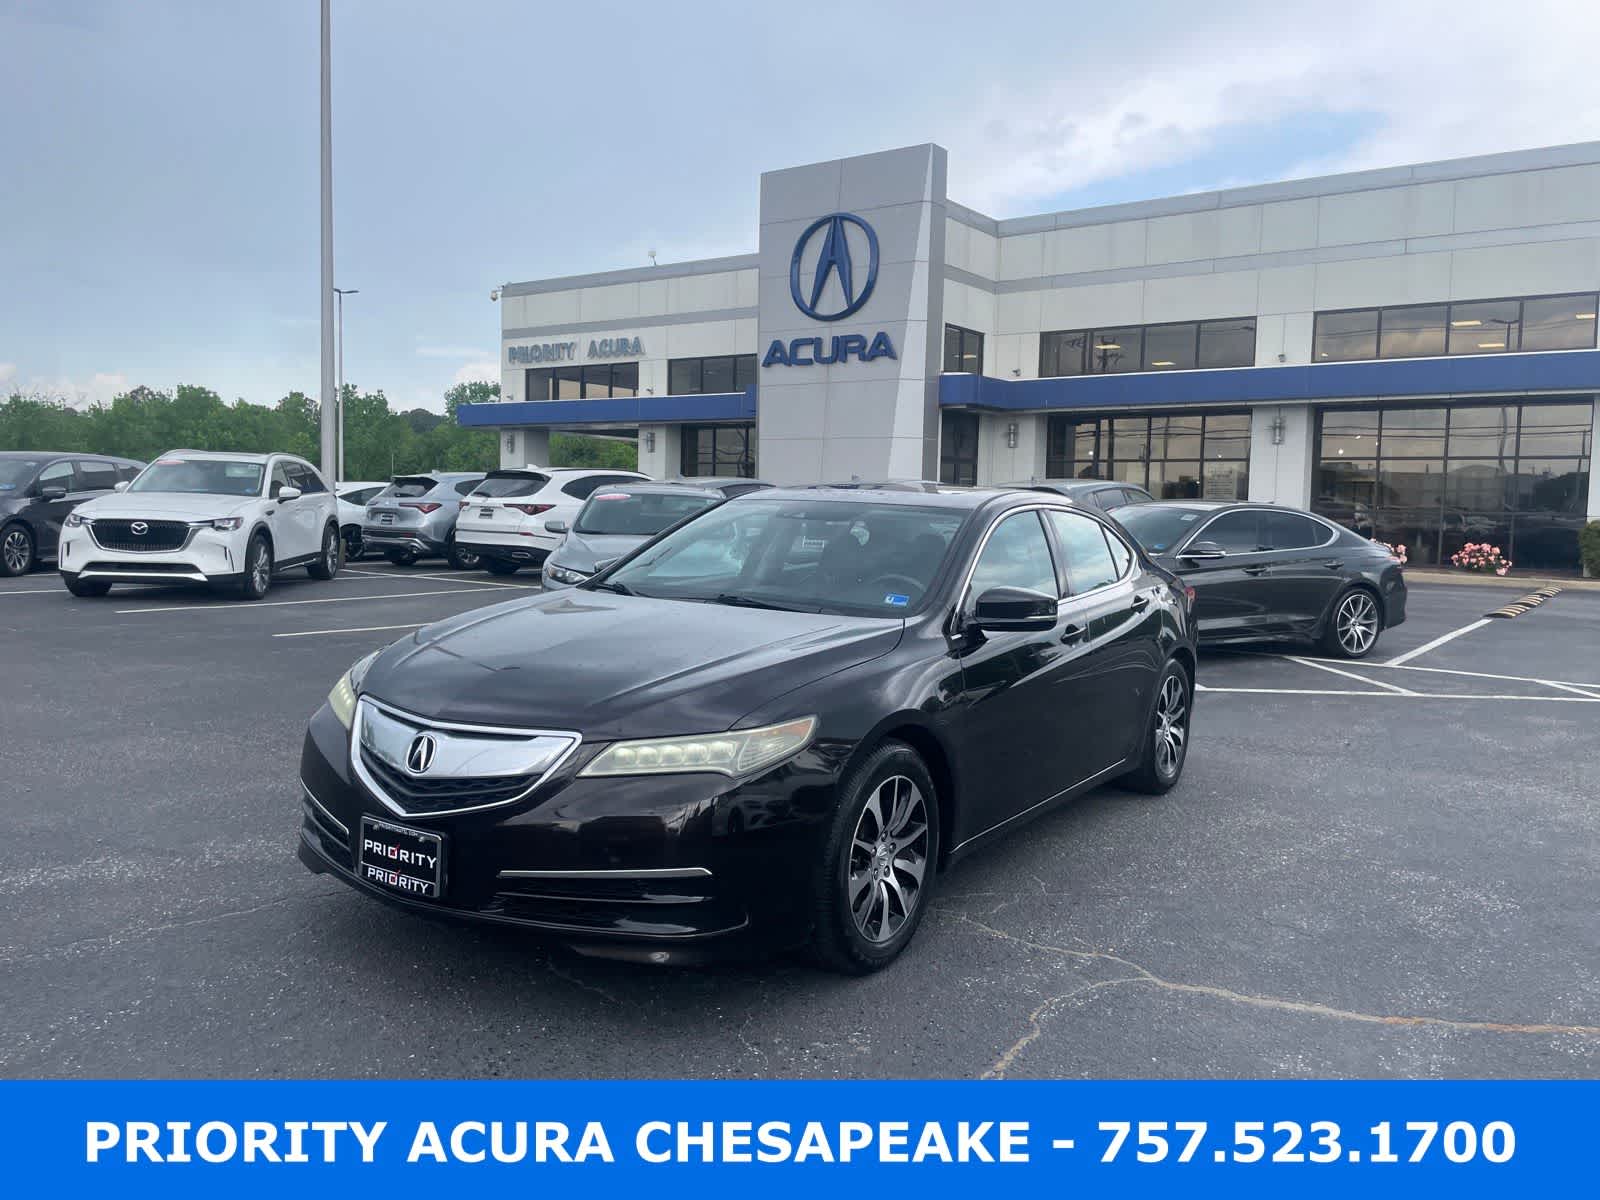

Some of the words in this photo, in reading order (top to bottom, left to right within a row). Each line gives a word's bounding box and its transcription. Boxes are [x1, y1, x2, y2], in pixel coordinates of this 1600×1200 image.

[508, 341, 576, 364] PRIORITY
[587, 336, 646, 359] ACURA
[761, 331, 898, 368] ACURA
[364, 839, 437, 869] PRIORITY
[367, 867, 429, 894] PRIORITY
